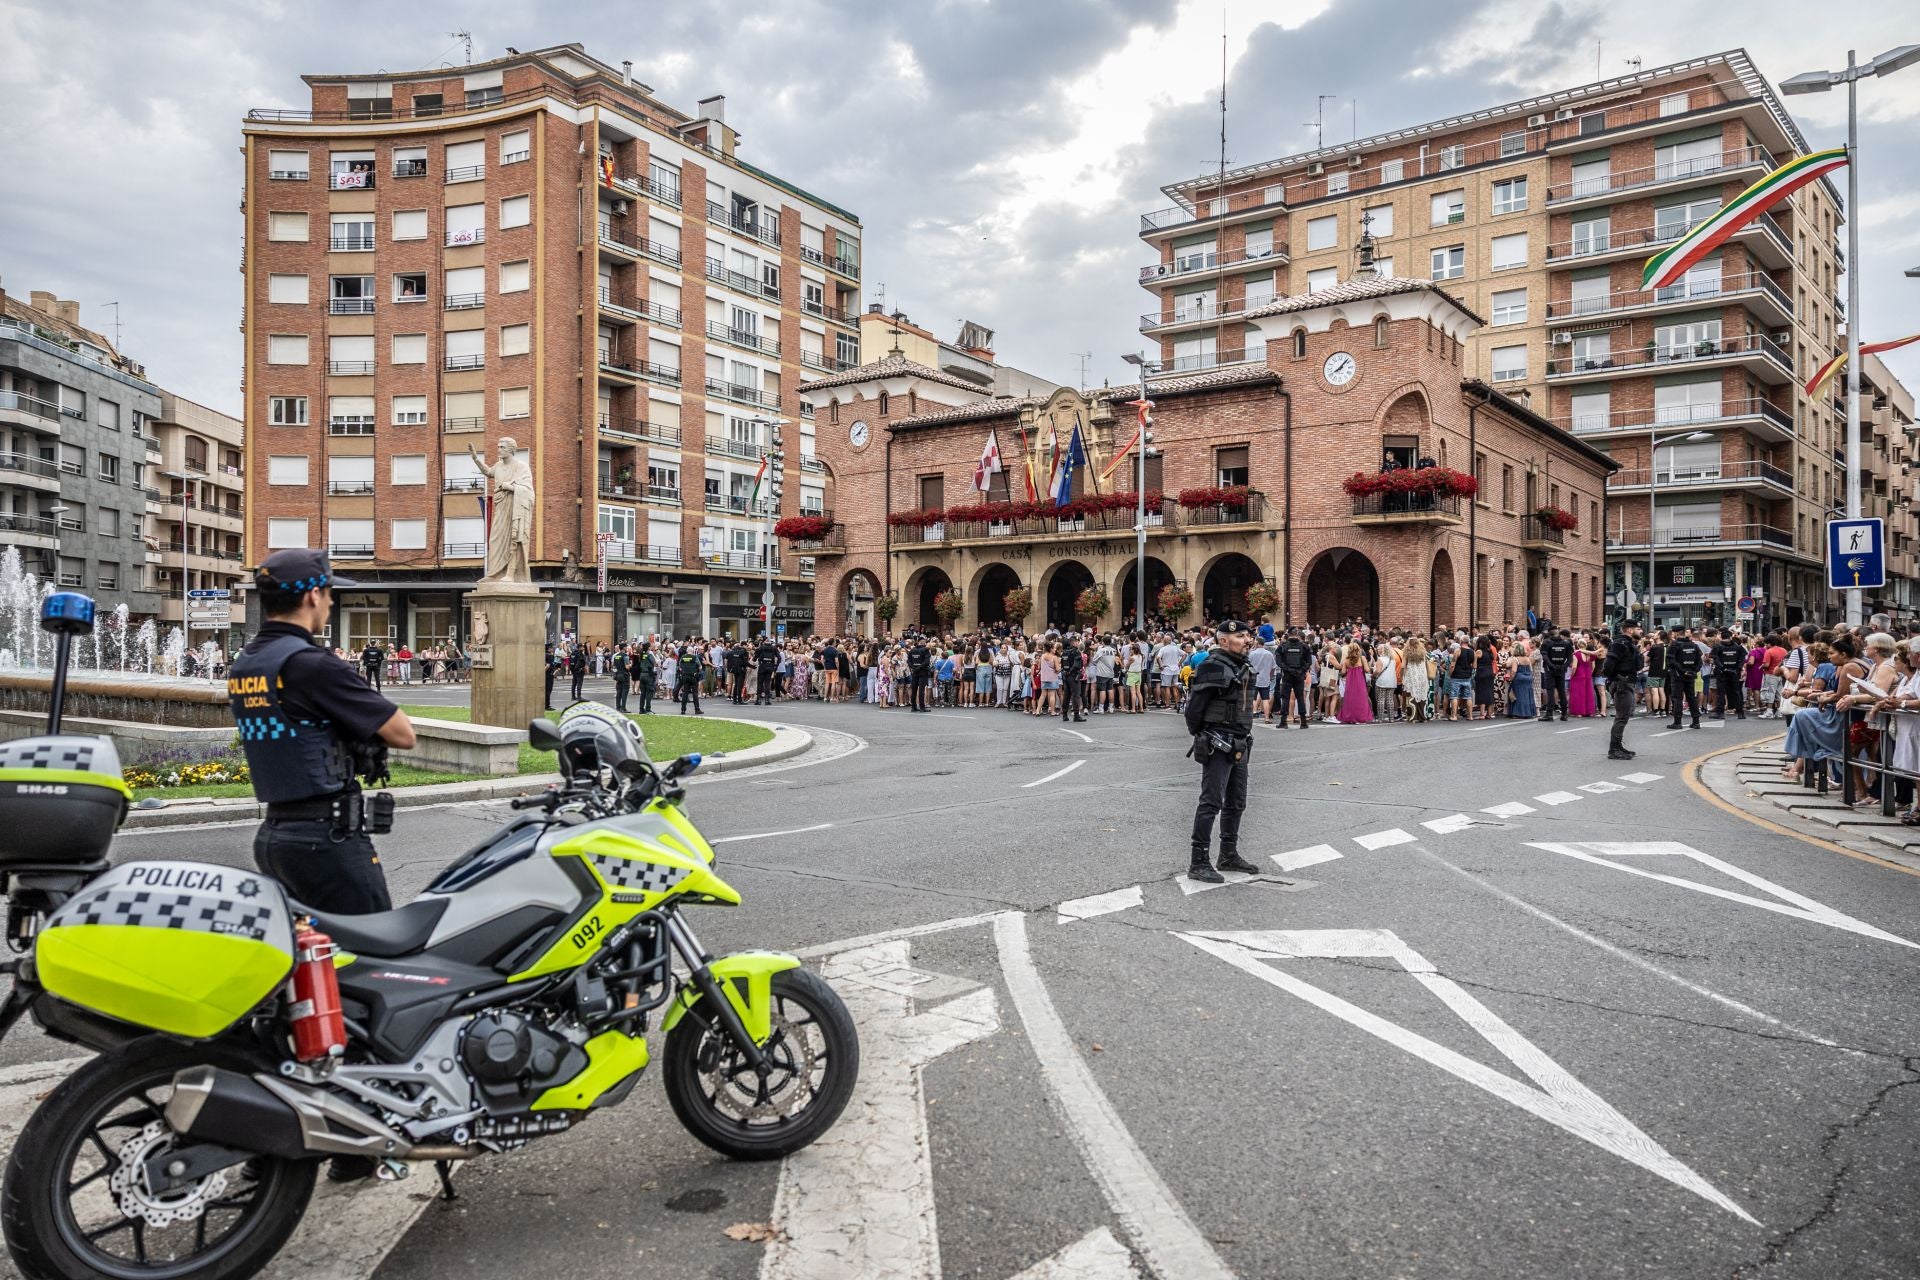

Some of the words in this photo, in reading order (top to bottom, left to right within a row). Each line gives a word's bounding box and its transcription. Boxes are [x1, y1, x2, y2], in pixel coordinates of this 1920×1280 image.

[340, 176, 361, 185] SOS
[454, 233, 472, 243] SOS
[596, 533, 614, 541] CAFE
[1002, 549, 1031, 560] CASA
[1049, 544, 1134, 557] CONSISTORIAL
[228, 676, 269, 694] OLICIA
[244, 697, 271, 708] LOCAL
[571, 720, 596, 728] LOCAL
[126, 867, 223, 892] POLICIA
[572, 916, 605, 949] 092
